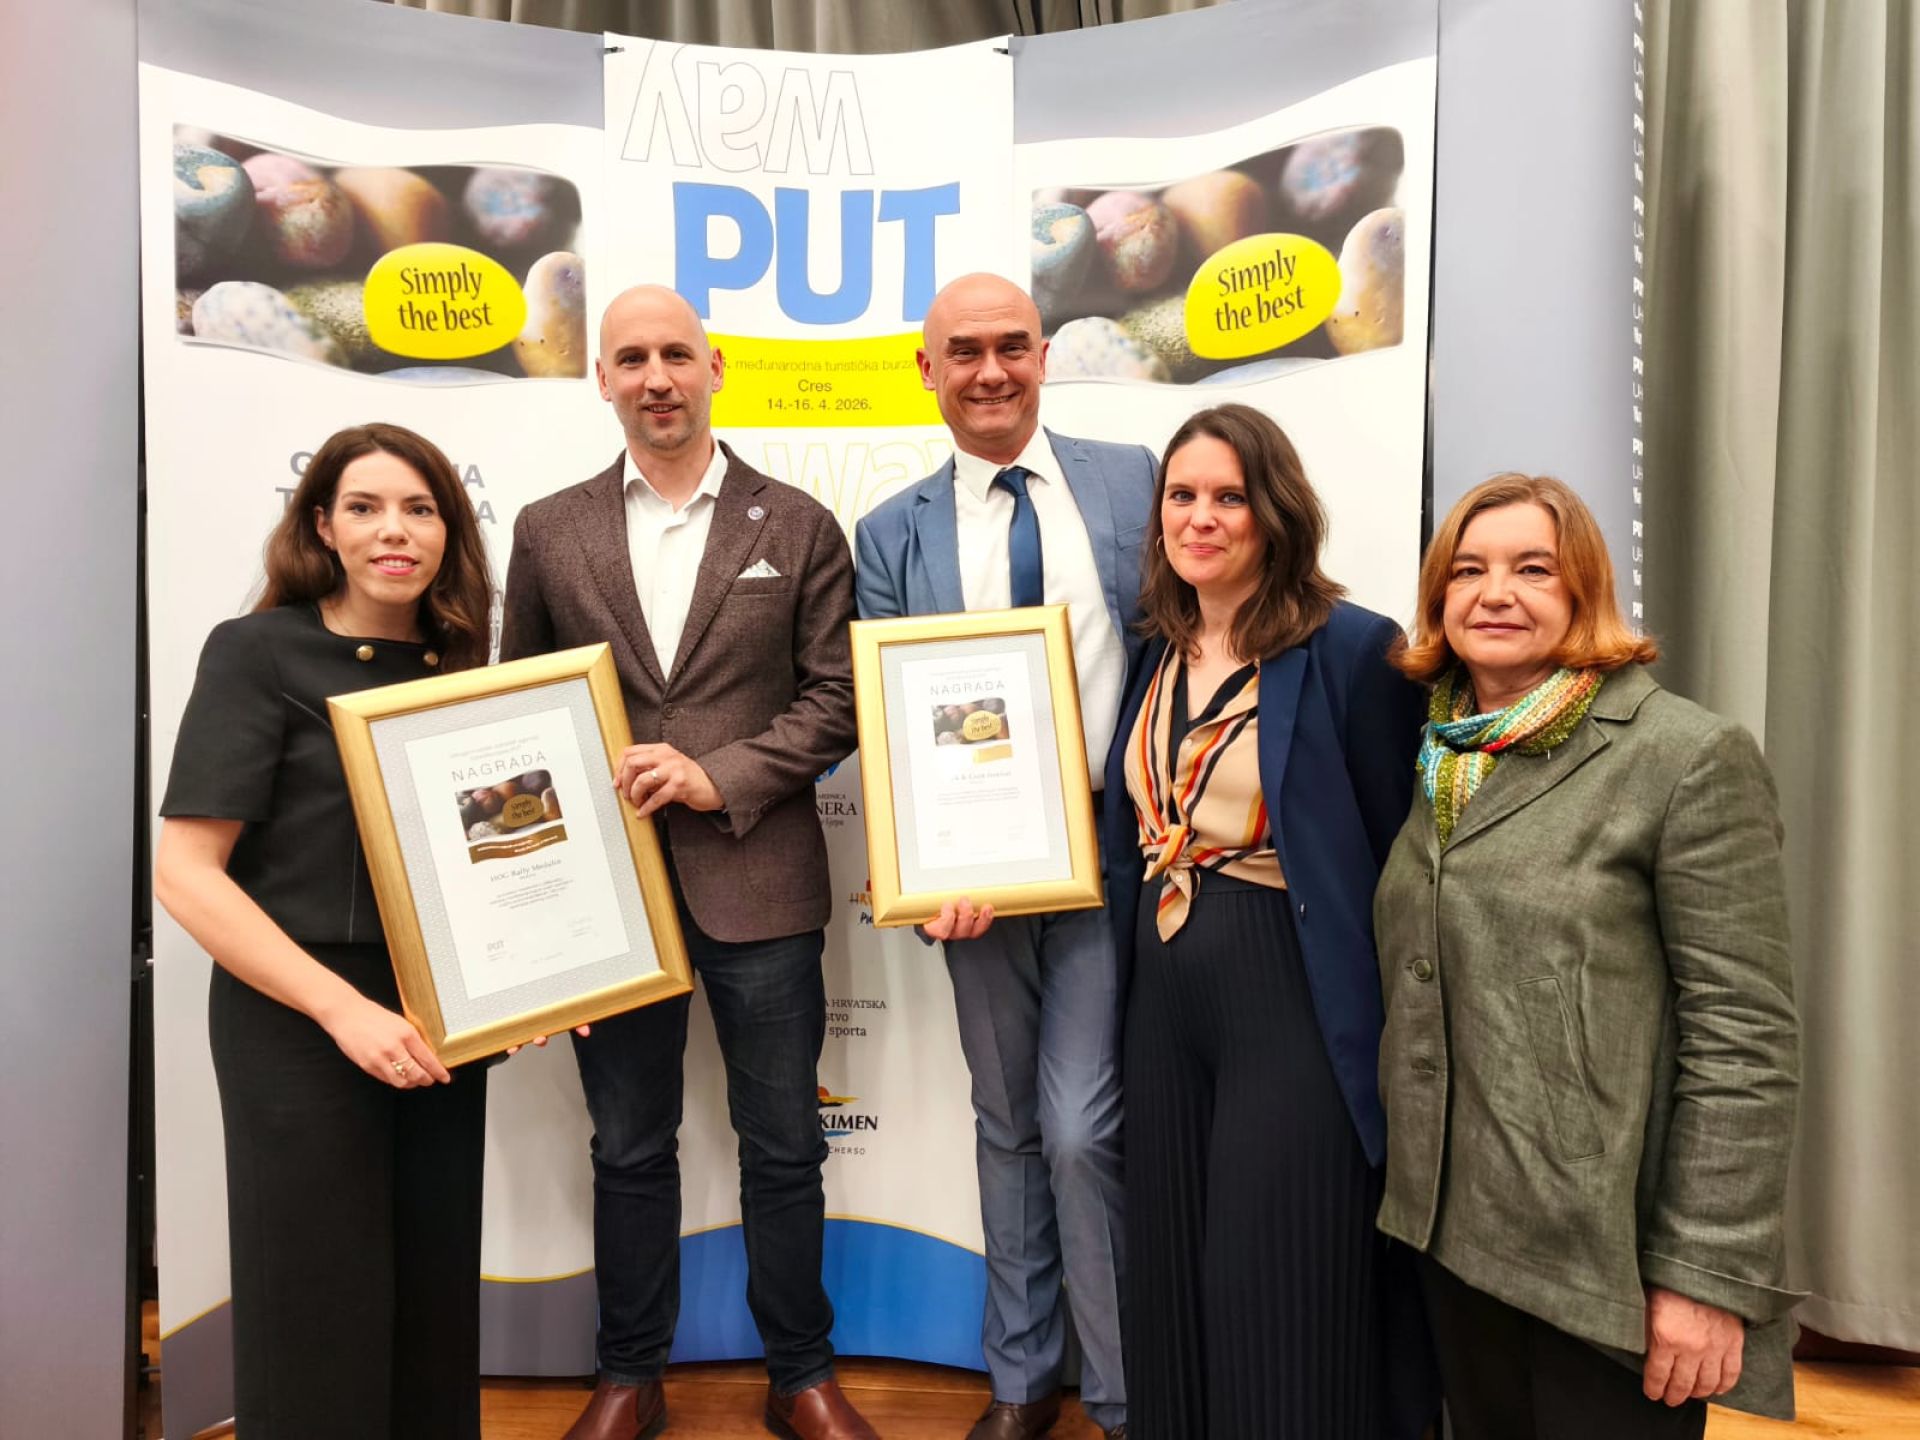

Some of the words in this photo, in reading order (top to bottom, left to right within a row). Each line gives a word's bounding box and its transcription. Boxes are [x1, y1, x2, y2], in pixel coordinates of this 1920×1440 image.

[621, 40, 874, 175] way
[672, 181, 960, 324] PUT
[400, 262, 482, 300] Simply
[1218, 249, 1297, 298] Simply
[398, 301, 440, 331] the
[442, 300, 493, 331] best
[1215, 302, 1252, 333] the
[1256, 285, 1305, 323] best
[735, 357, 822, 372] međunarodna
[825, 359, 878, 372] turistička
[882, 357, 915, 370] burza
[798, 379, 832, 392] Cres
[767, 398, 814, 410] 14.-16.
[818, 398, 831, 410] 4.
[835, 398, 872, 410] 2026.
[930, 680, 1005, 696] NAGRADA
[451, 750, 547, 782] NAGRADA
[816, 802, 857, 816] NERA
[832, 999, 887, 1009] HRVATSKA
[824, 1013, 849, 1022] stvo
[828, 1026, 867, 1038] sporta
[820, 1114, 878, 1131] KIMEN
